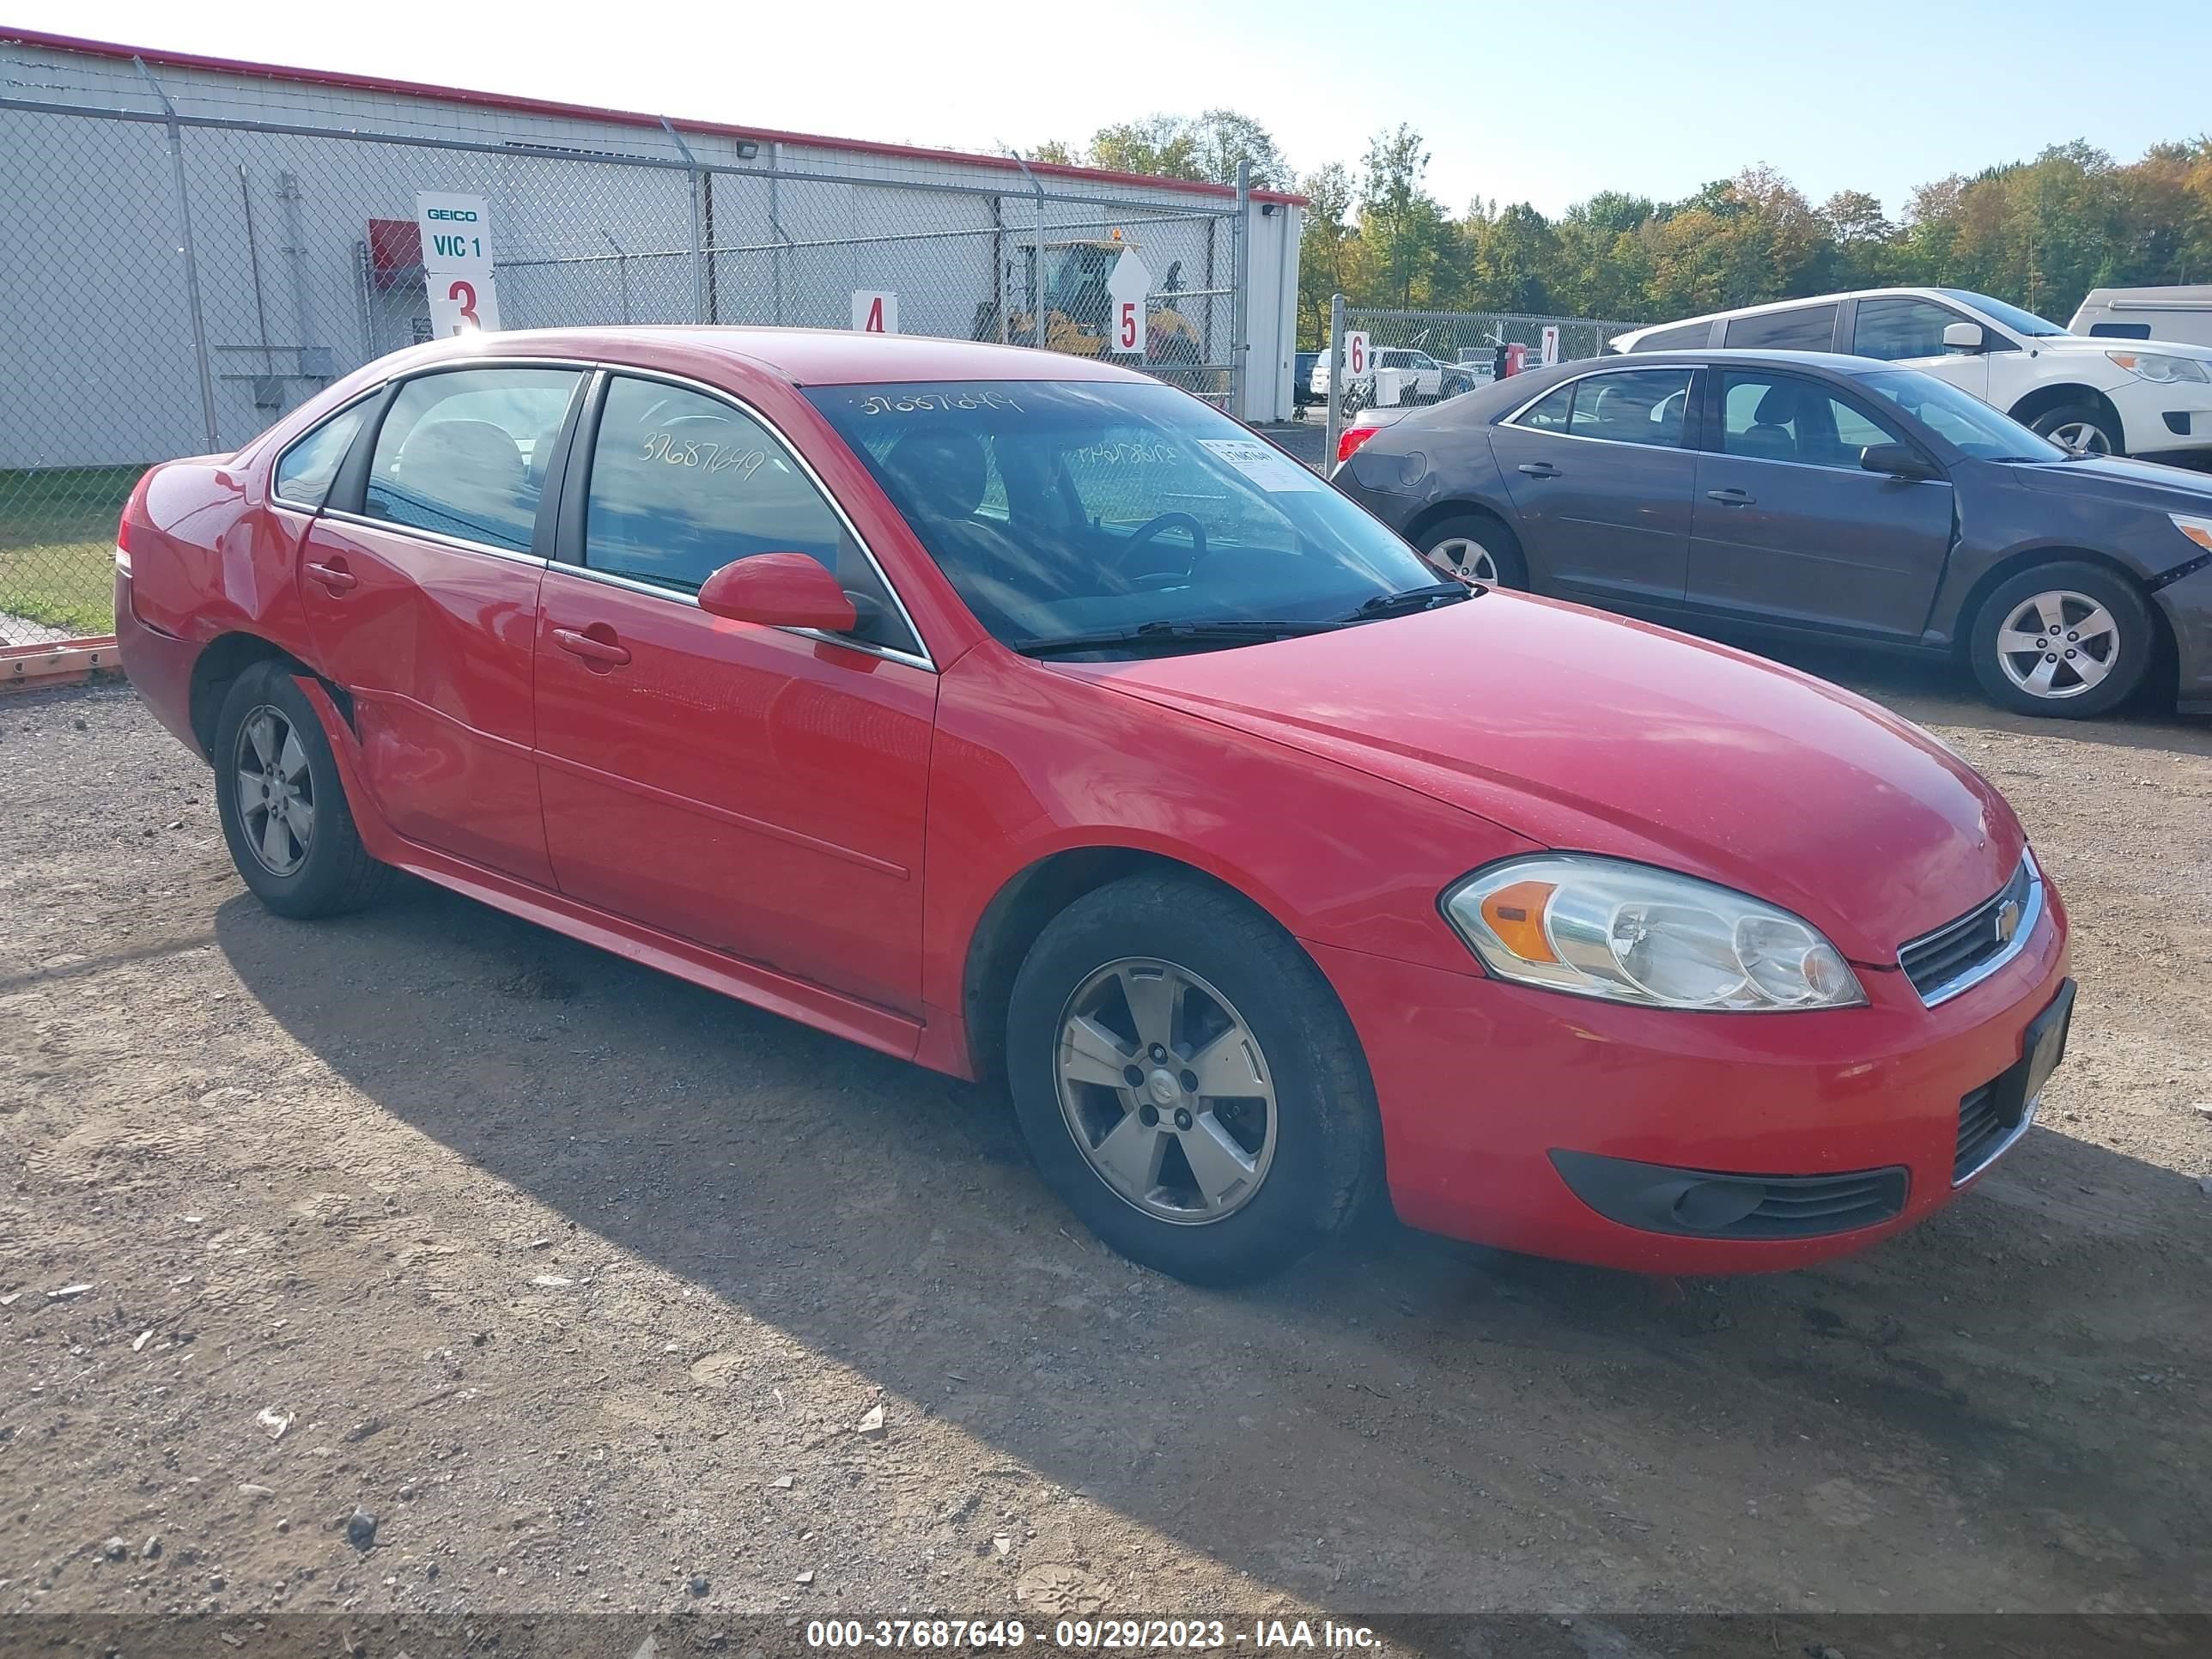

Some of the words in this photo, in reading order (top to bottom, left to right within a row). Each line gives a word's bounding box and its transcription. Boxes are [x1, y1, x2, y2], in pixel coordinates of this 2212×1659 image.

[428, 209, 477, 222] GEICO
[434, 234, 465, 257] VIC
[471, 237, 481, 257] 1
[449, 281, 482, 337] 3
[1121, 303, 1135, 348] 5
[1352, 336, 1364, 374] 6
[1547, 331, 1554, 362] 7
[638, 431, 766, 481] 37687649
